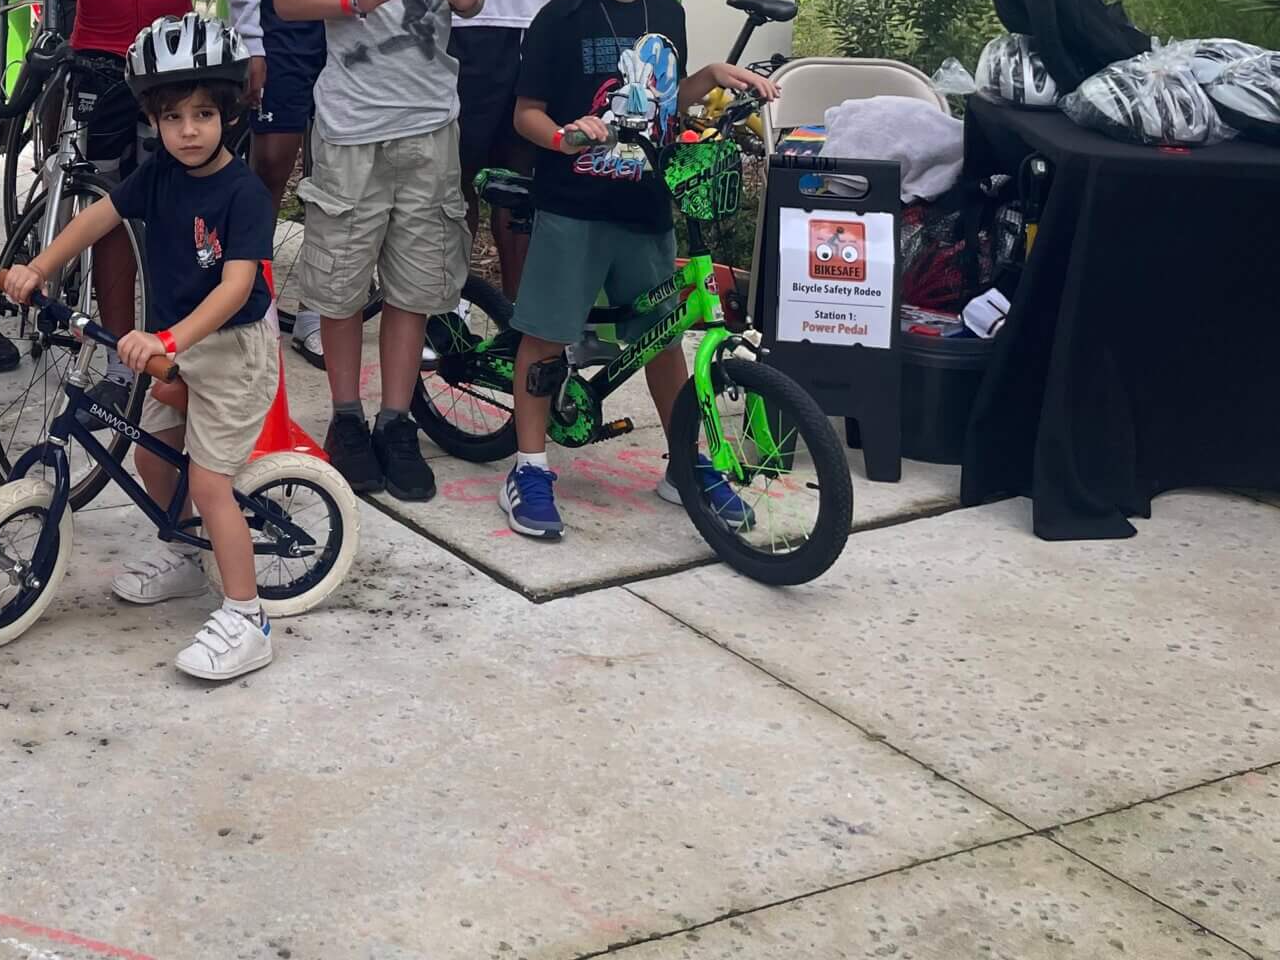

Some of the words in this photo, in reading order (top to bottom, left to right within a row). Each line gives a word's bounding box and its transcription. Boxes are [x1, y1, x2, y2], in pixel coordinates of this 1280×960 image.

[814, 264, 860, 278] BIKESAFE
[792, 282, 822, 294] Bicycle
[824, 284, 852, 296] Safety
[854, 286, 881, 297] Rodeo
[814, 310, 846, 320] Station
[849, 312, 857, 321] 1:
[802, 321, 836, 333] Power
[838, 323, 868, 335] Pedal
[608, 301, 688, 381] SCHWINN
[89, 403, 141, 440] BANWOOD
